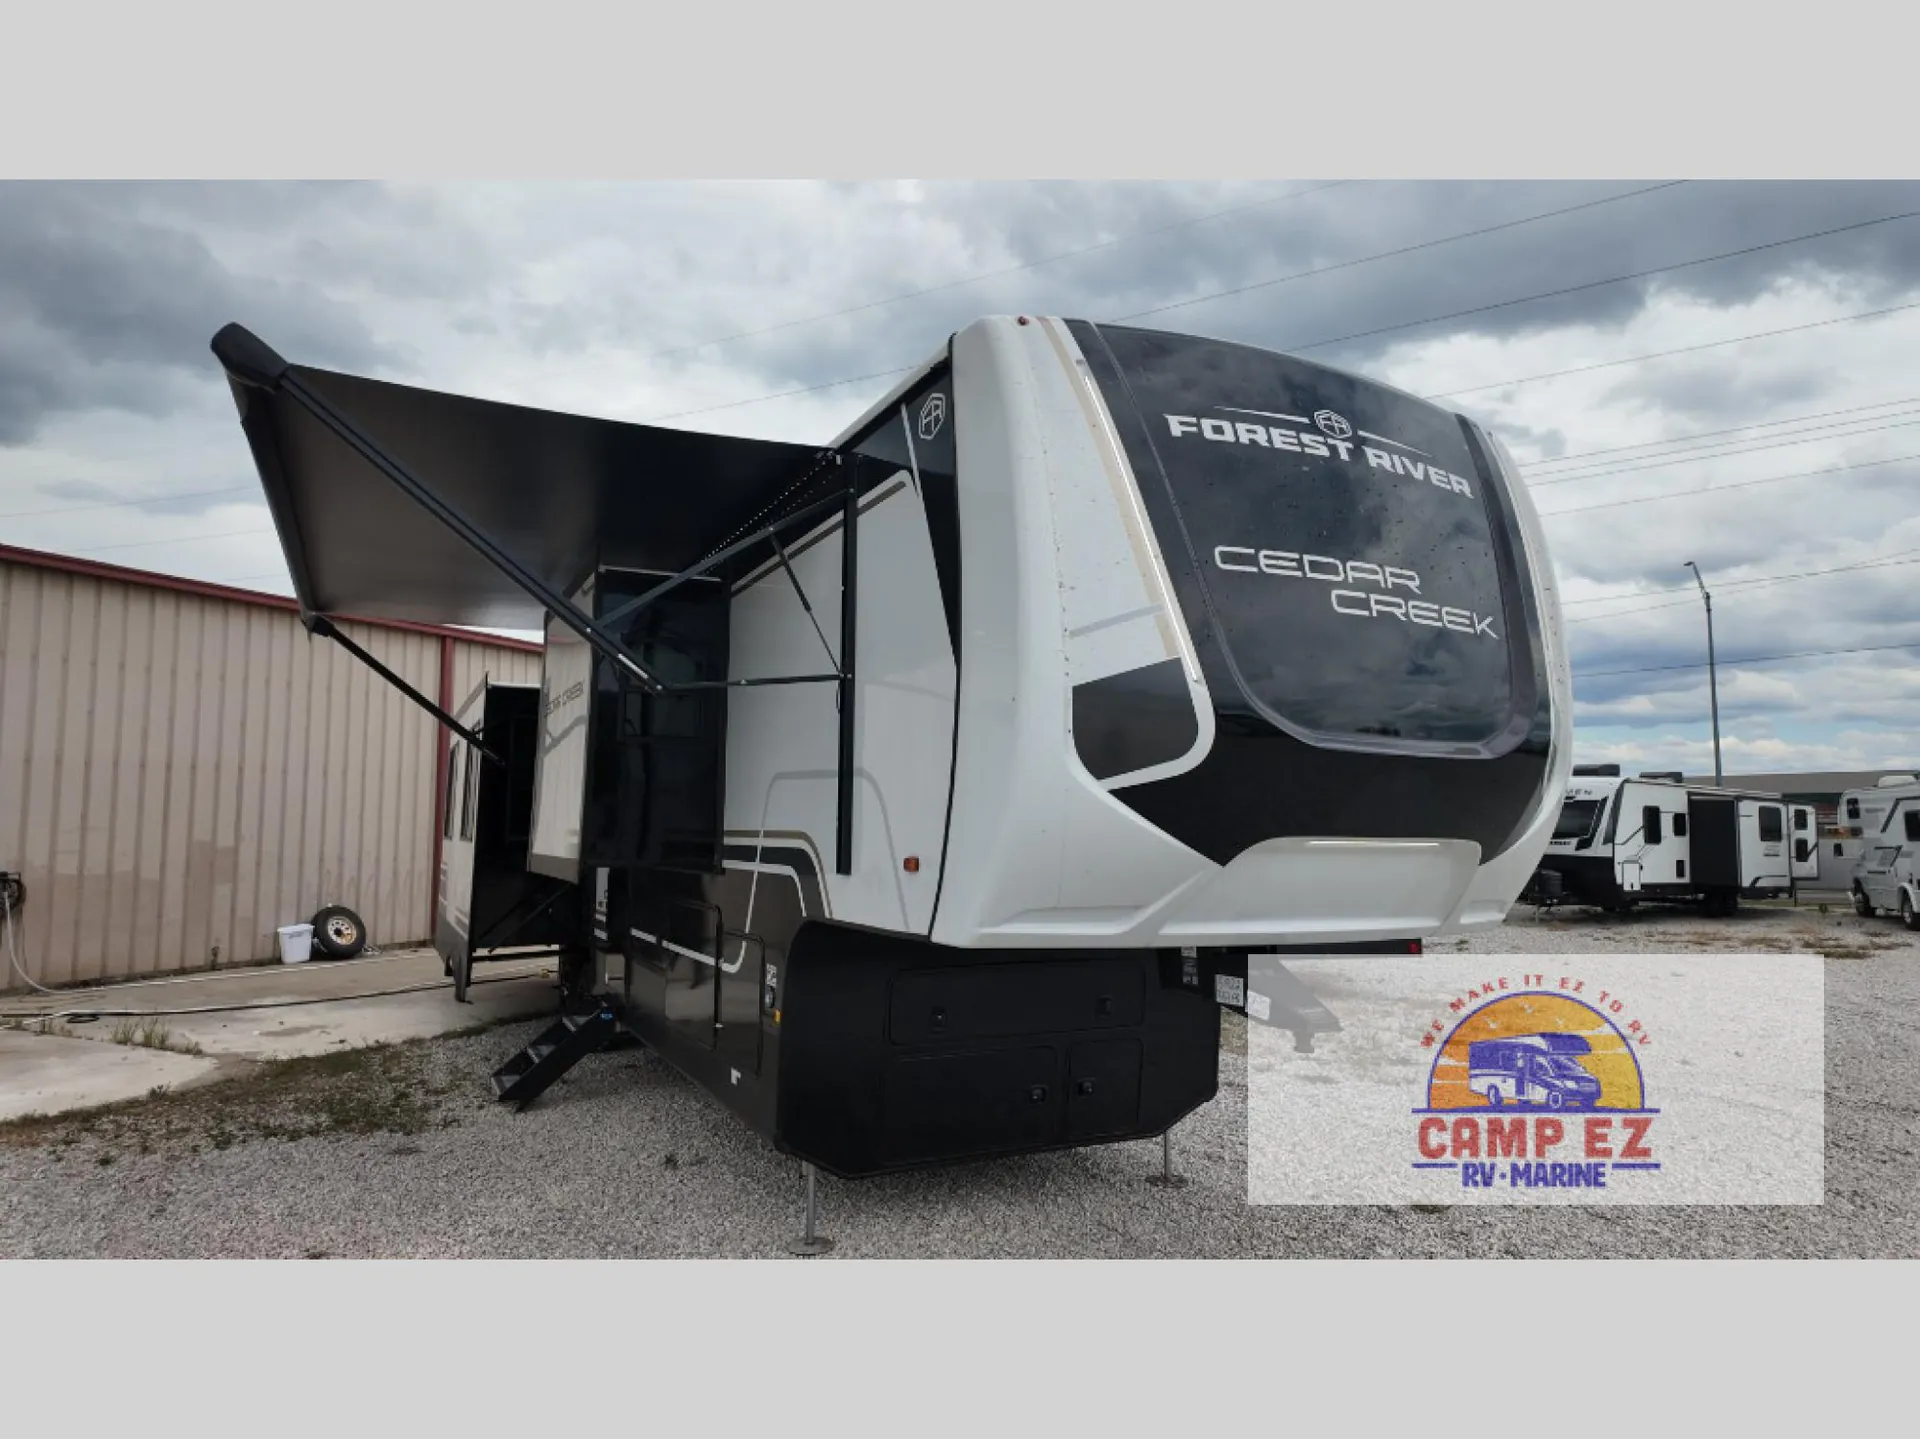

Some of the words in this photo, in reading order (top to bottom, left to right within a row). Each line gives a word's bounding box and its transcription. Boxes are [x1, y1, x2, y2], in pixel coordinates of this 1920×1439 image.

[1163, 413, 1354, 462] FOREST
[1364, 446, 1475, 499] RIVER
[1214, 545, 1422, 595] CEDAR
[1330, 589, 1500, 640] CREEK
